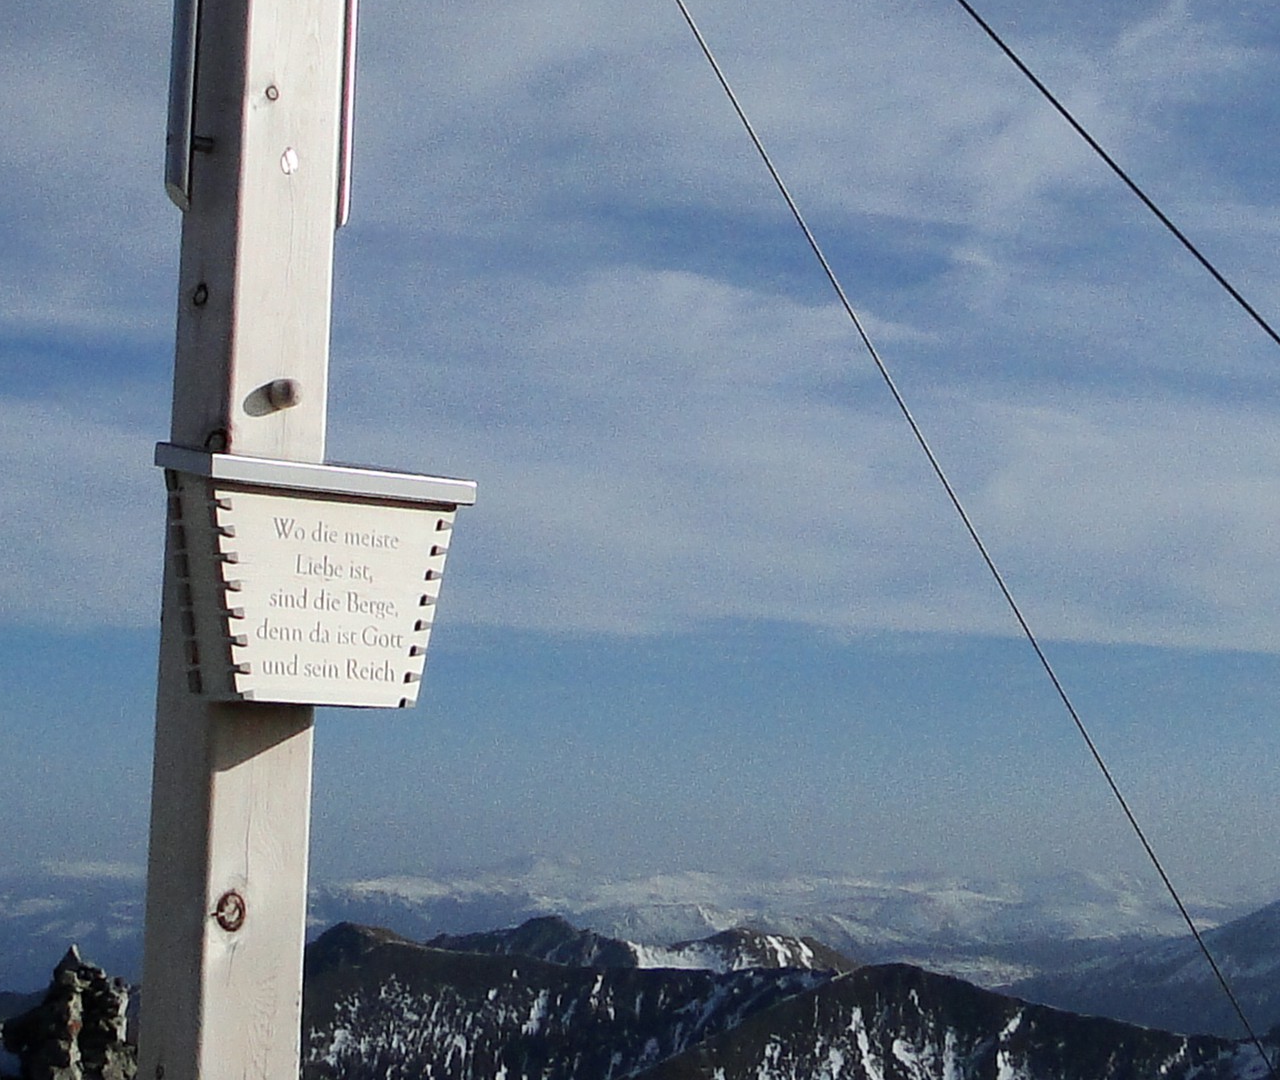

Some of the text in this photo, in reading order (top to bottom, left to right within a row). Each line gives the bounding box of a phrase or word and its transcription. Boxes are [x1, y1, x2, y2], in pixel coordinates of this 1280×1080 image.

[273, 518, 399, 550] Wo die meiste
[296, 554, 373, 583] Liebe ist,
[269, 588, 308, 610] sind
[313, 591, 340, 612] die
[256, 619, 403, 649] denn da ist Gott
[262, 654, 395, 683] und sein Reich
